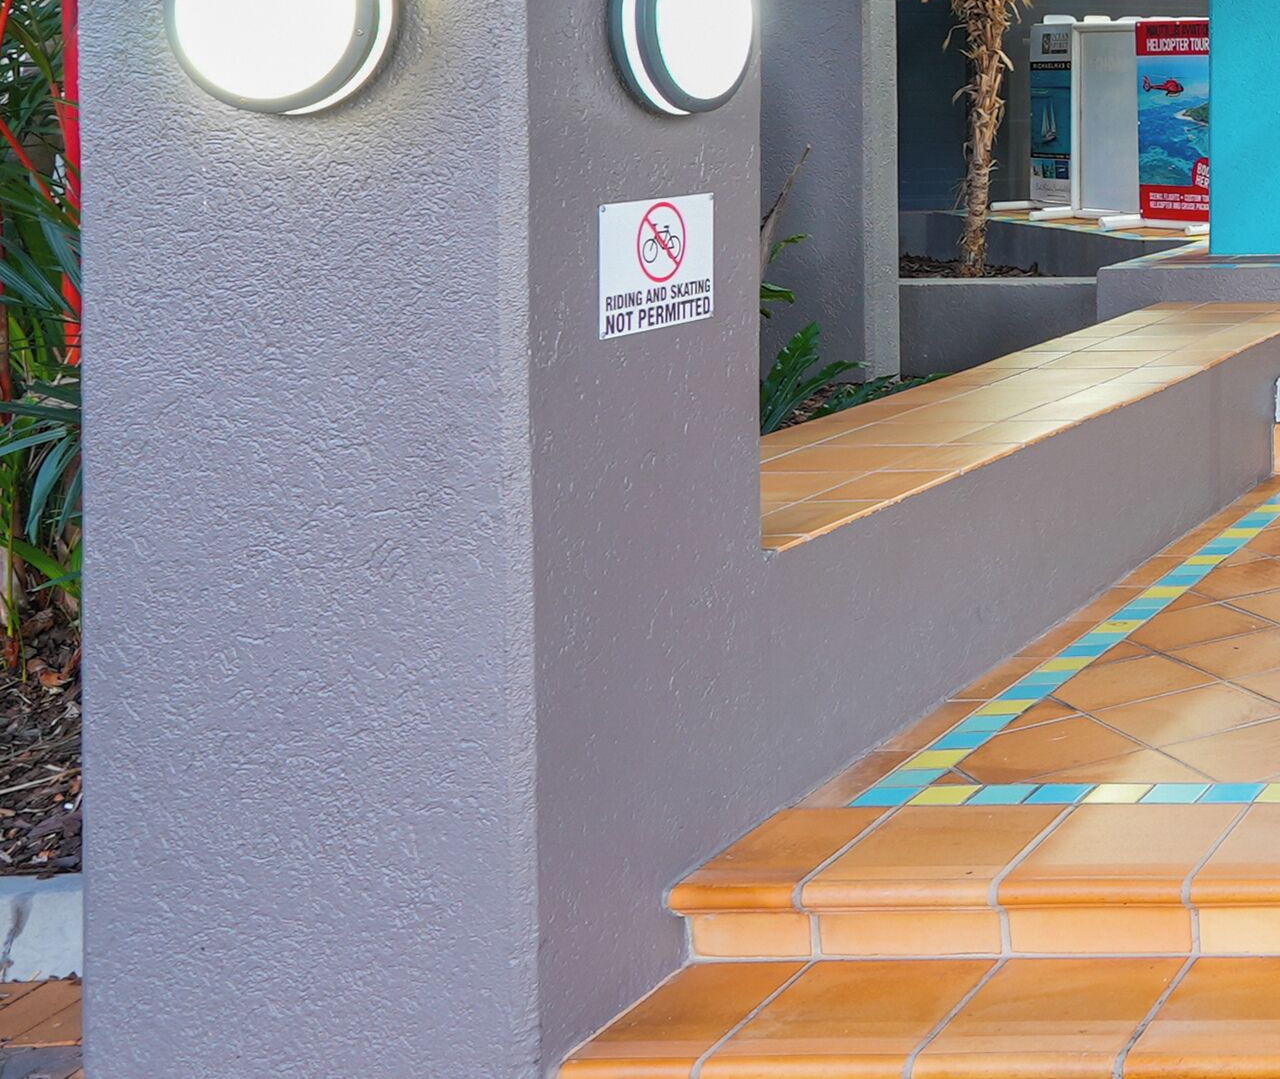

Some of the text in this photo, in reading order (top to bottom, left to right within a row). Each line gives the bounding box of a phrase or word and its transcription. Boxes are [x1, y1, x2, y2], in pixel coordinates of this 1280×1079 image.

[1146, 38, 1189, 51] HELICOPTER
[605, 278, 711, 312] RIDING AND SKATING
[605, 296, 710, 335] NOT PERMITTED
